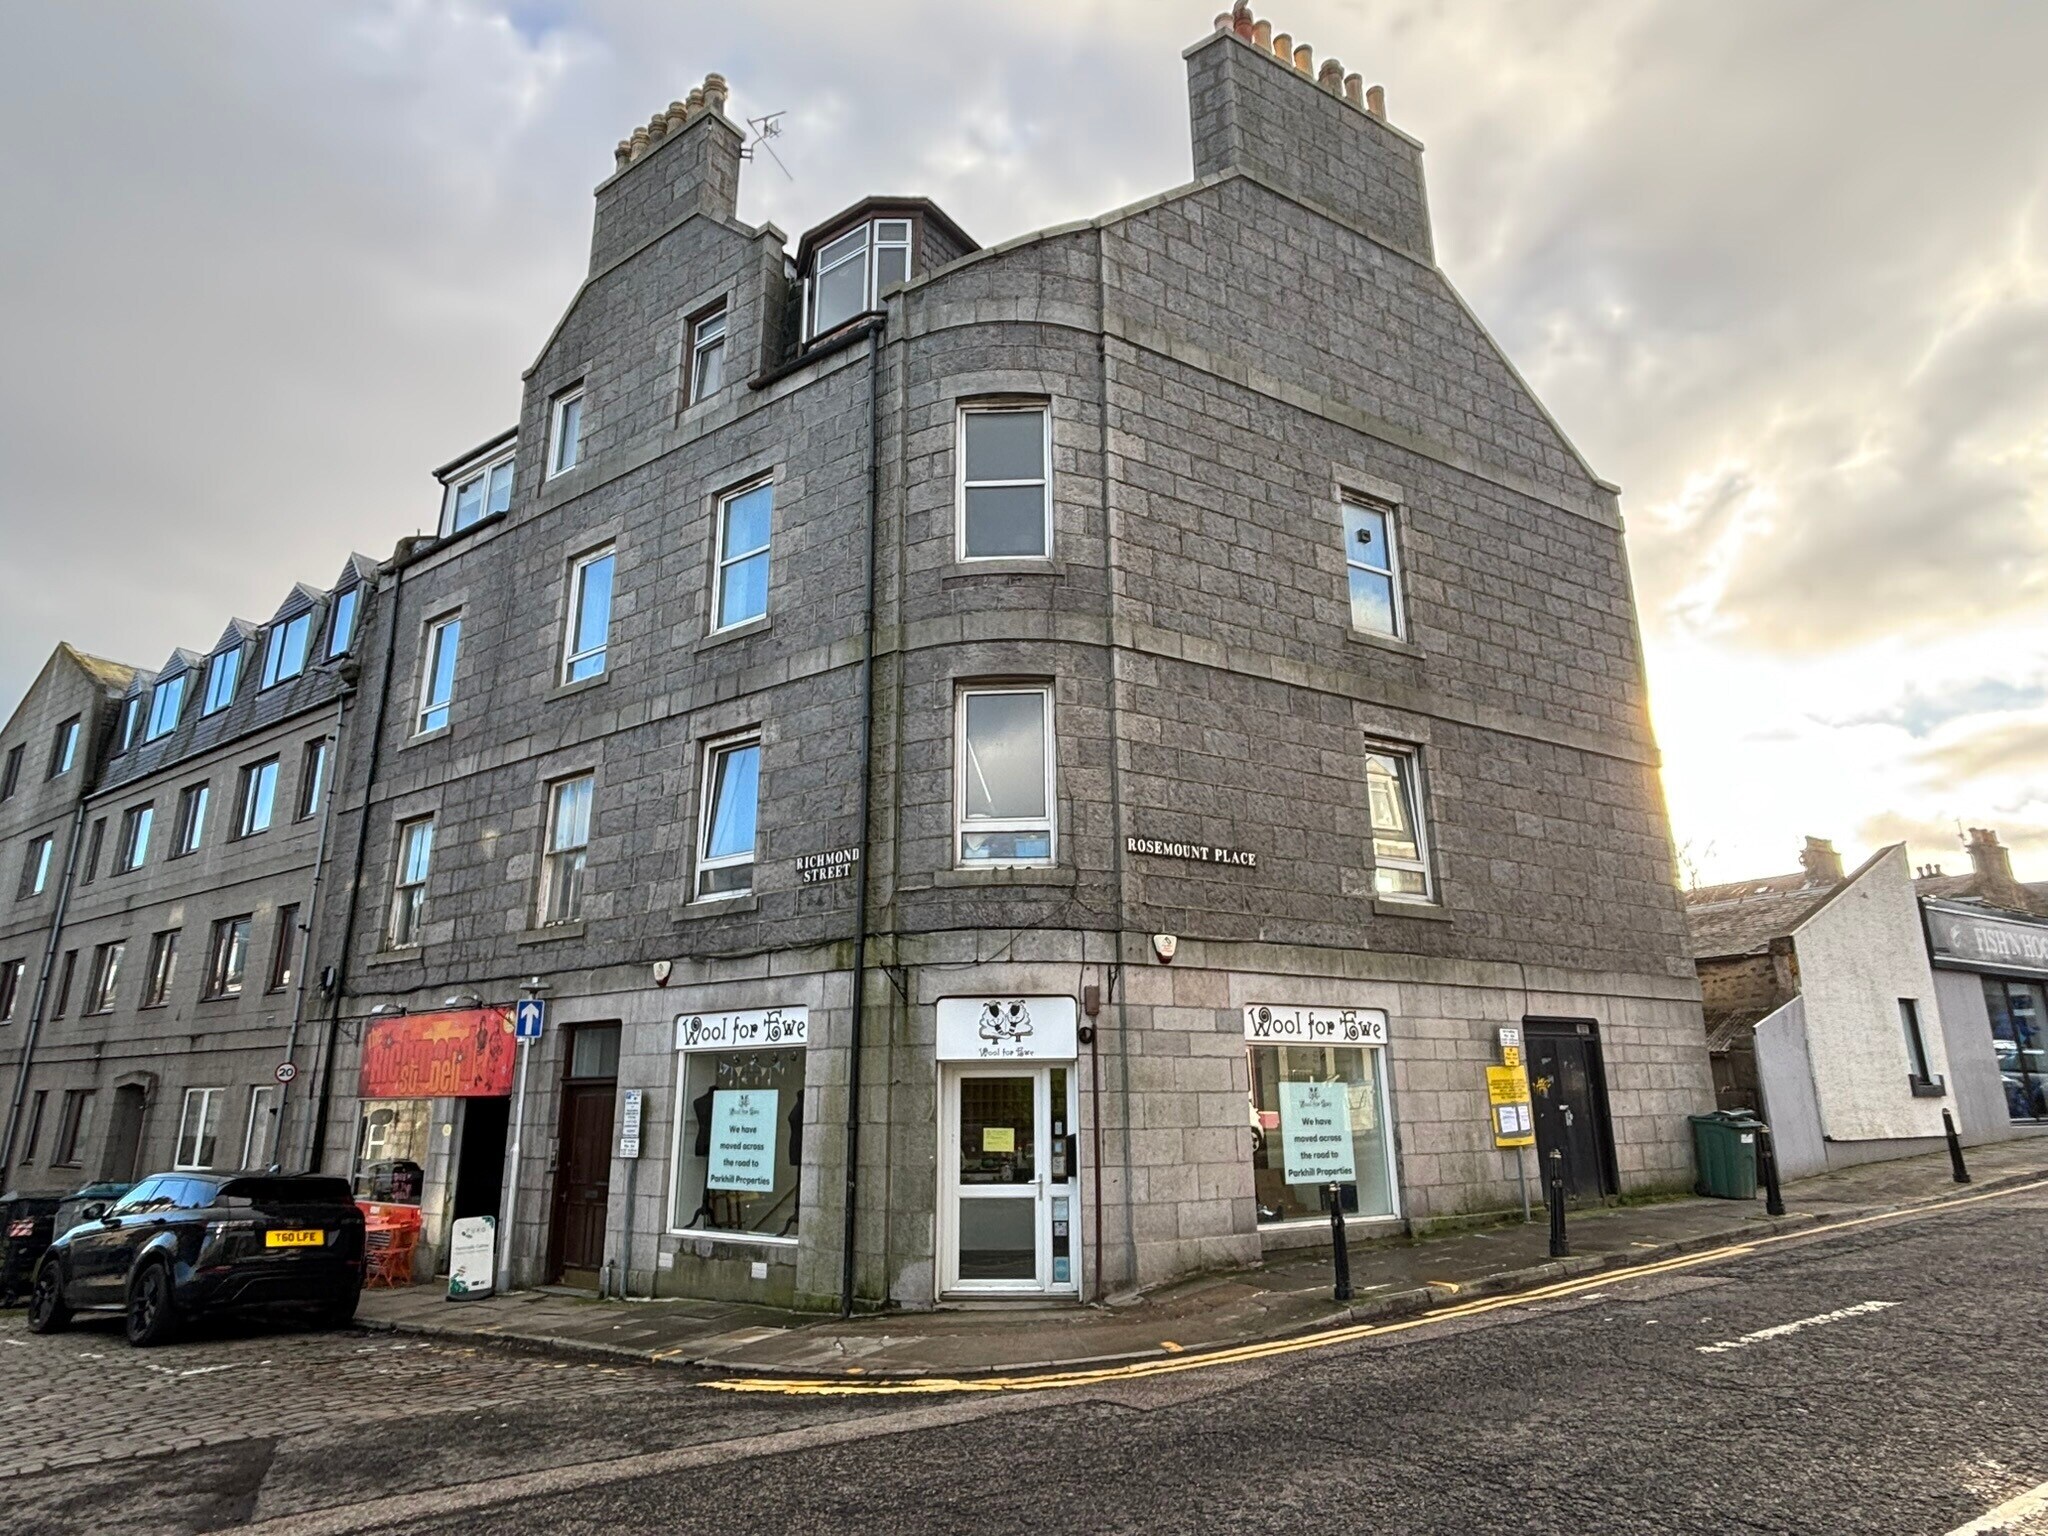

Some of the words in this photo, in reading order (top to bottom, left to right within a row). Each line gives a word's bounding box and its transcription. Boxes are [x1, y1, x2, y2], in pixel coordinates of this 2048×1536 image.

[1127, 838, 1209, 860] ROSEMOUNT
[1214, 848, 1256, 866] PLACE
[796, 848, 860, 871] RICHMOND
[803, 862, 851, 883] STREET
[682, 1016, 728, 1046] Wool
[732, 1016, 759, 1045] for
[763, 1010, 806, 1042] Ewe
[1248, 1007, 1302, 1037] Wool
[1308, 1011, 1335, 1040] for
[1339, 1010, 1381, 1041] Ewe
[279, 1068, 293, 1076] 20
[1301, 1118, 1314, 1126] We
[1315, 1117, 1332, 1126] have
[729, 1125, 741, 1134] We
[741, 1125, 757, 1134] have
[1294, 1134, 1318, 1143] moved
[1319, 1134, 1342, 1142] across
[720, 1142, 741, 1150] moved
[742, 1143, 765, 1151] across
[1300, 1151, 1312, 1160] the
[1313, 1150, 1330, 1159] road
[1331, 1151, 1339, 1159] to
[723, 1158, 734, 1167] the
[735, 1158, 751, 1167] road
[752, 1159, 759, 1167] to
[1288, 1168, 1315, 1177] Parkhill
[1316, 1166, 1352, 1176] Properties
[710, 1174, 735, 1183] Parkhill
[735, 1175, 771, 1186] Properties
[275, 1233, 295, 1242] T60
[296, 1232, 316, 1241] LFE
